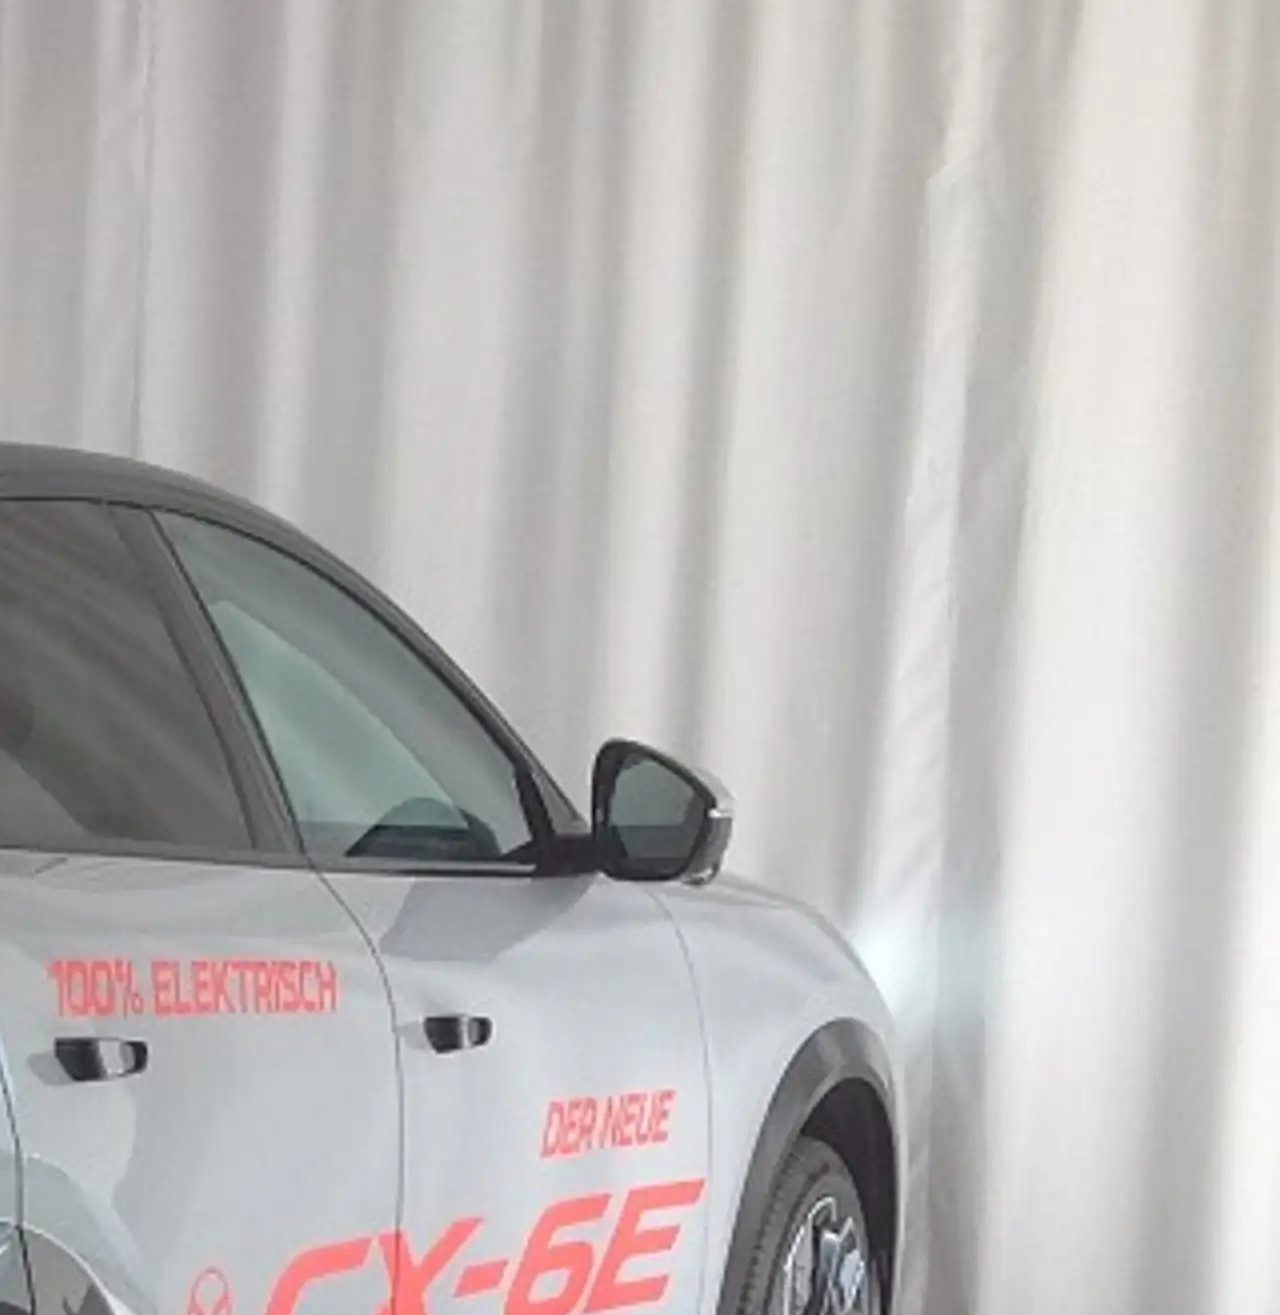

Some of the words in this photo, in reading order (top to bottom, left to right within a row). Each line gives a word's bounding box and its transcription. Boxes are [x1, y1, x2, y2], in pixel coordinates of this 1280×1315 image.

[48, 958, 144, 1016] 100%
[150, 958, 338, 1016] ELEKTRISCH
[541, 1096, 599, 1157] DER
[598, 1089, 676, 1148] NEUE
